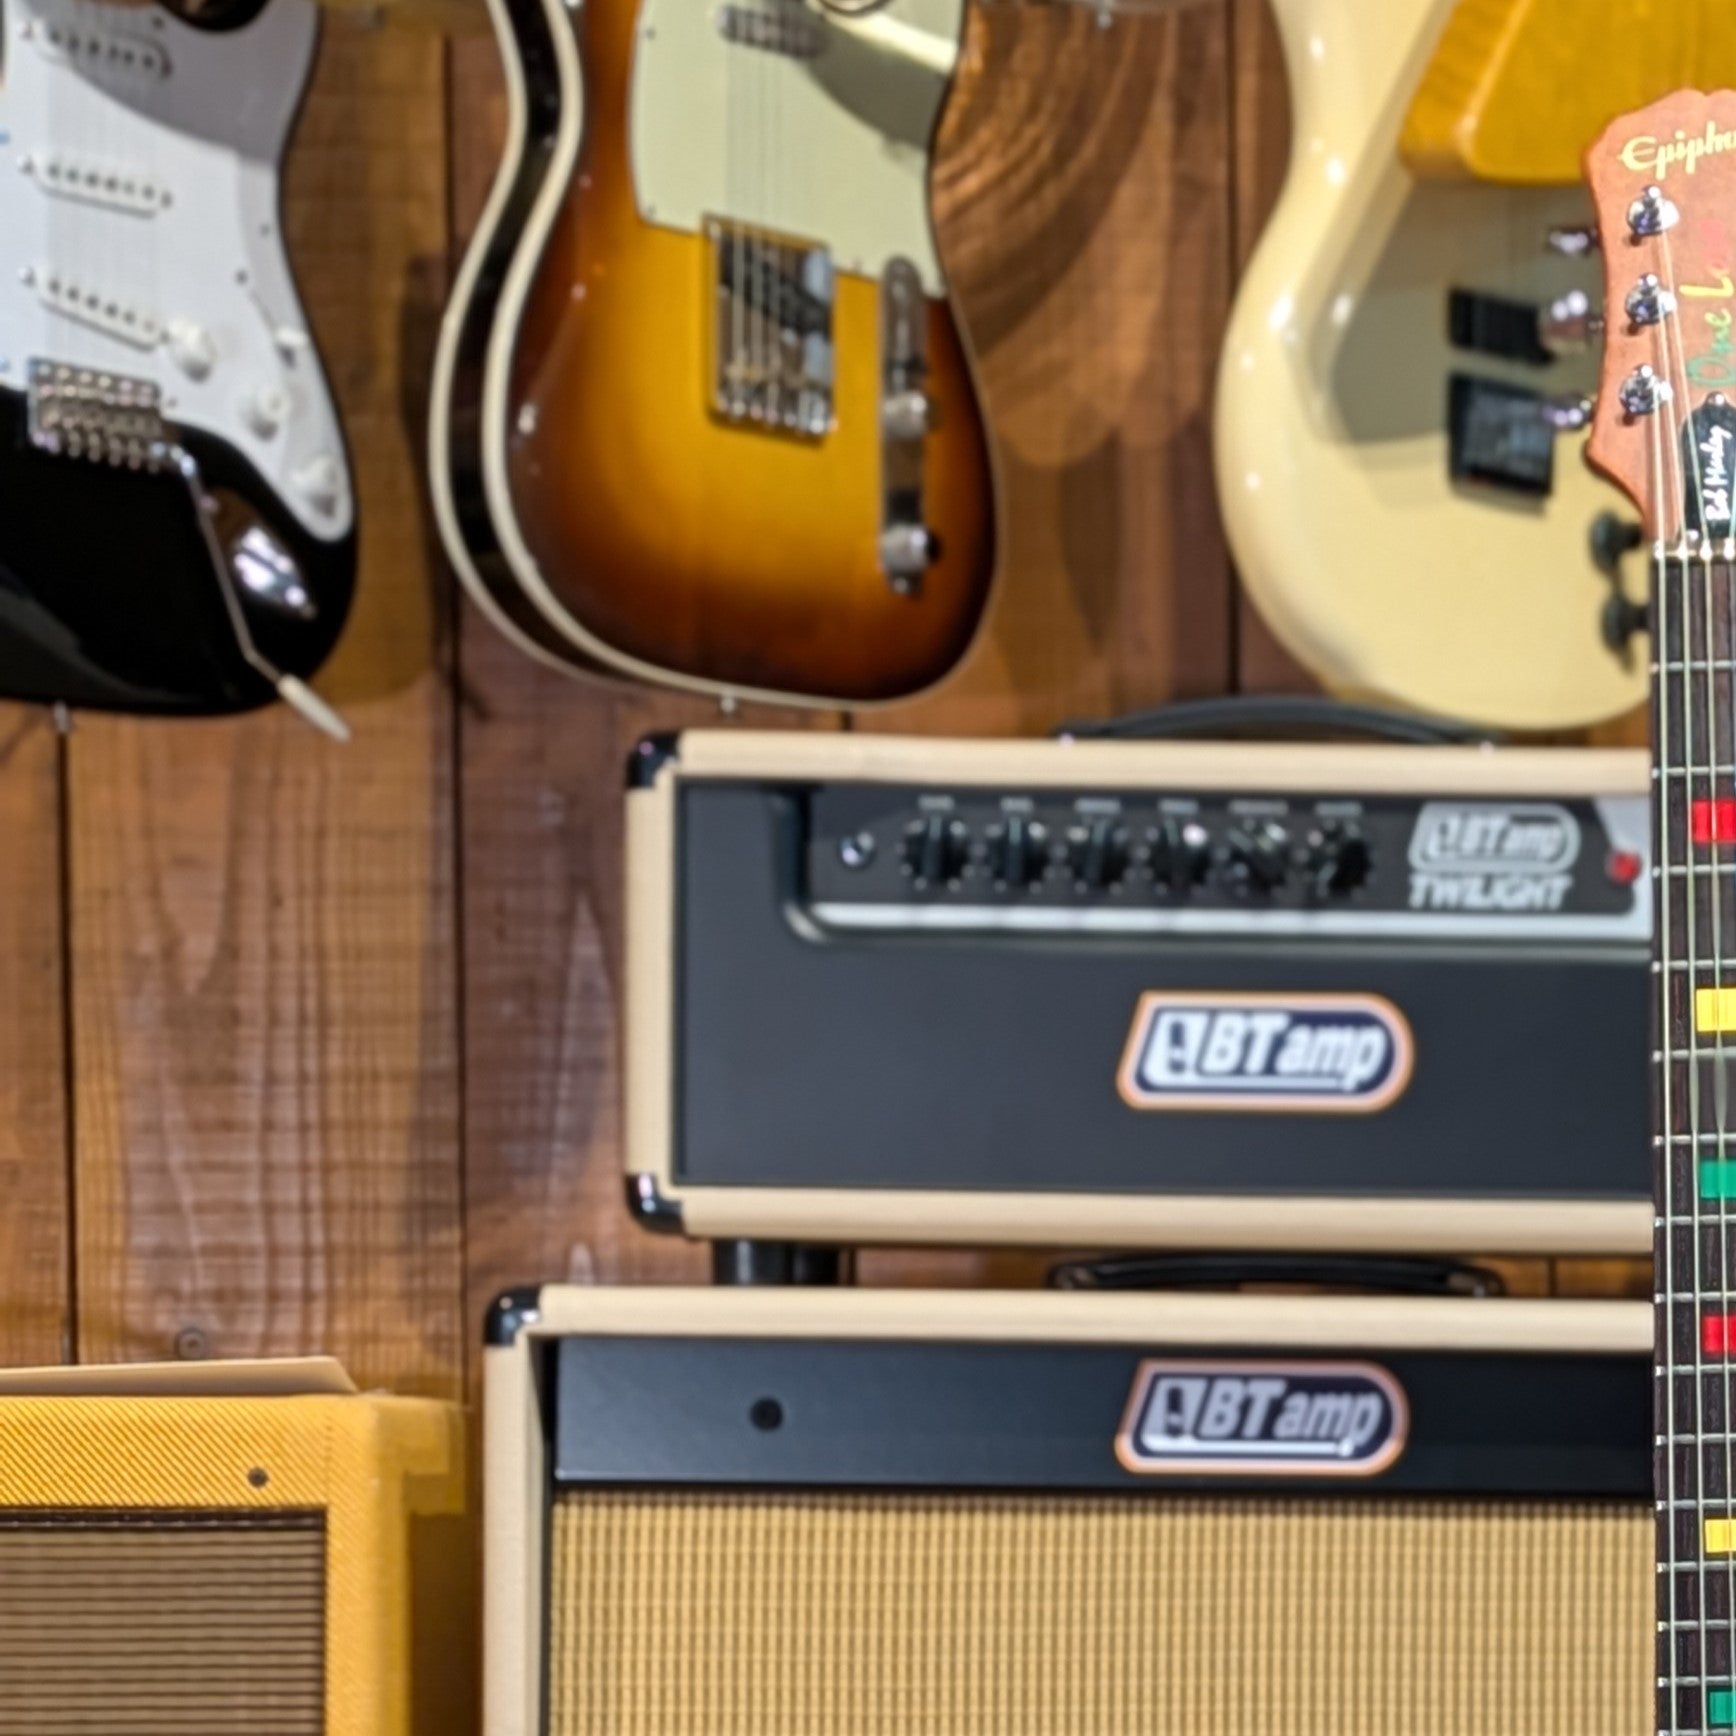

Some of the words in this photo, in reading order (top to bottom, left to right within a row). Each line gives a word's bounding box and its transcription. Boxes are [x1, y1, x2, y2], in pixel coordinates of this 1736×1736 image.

[1200, 1011, 1290, 1076] BT
[1274, 1024, 1388, 1091] amp
[1199, 1378, 1287, 1438] BT
[1272, 1391, 1383, 1456] amp
